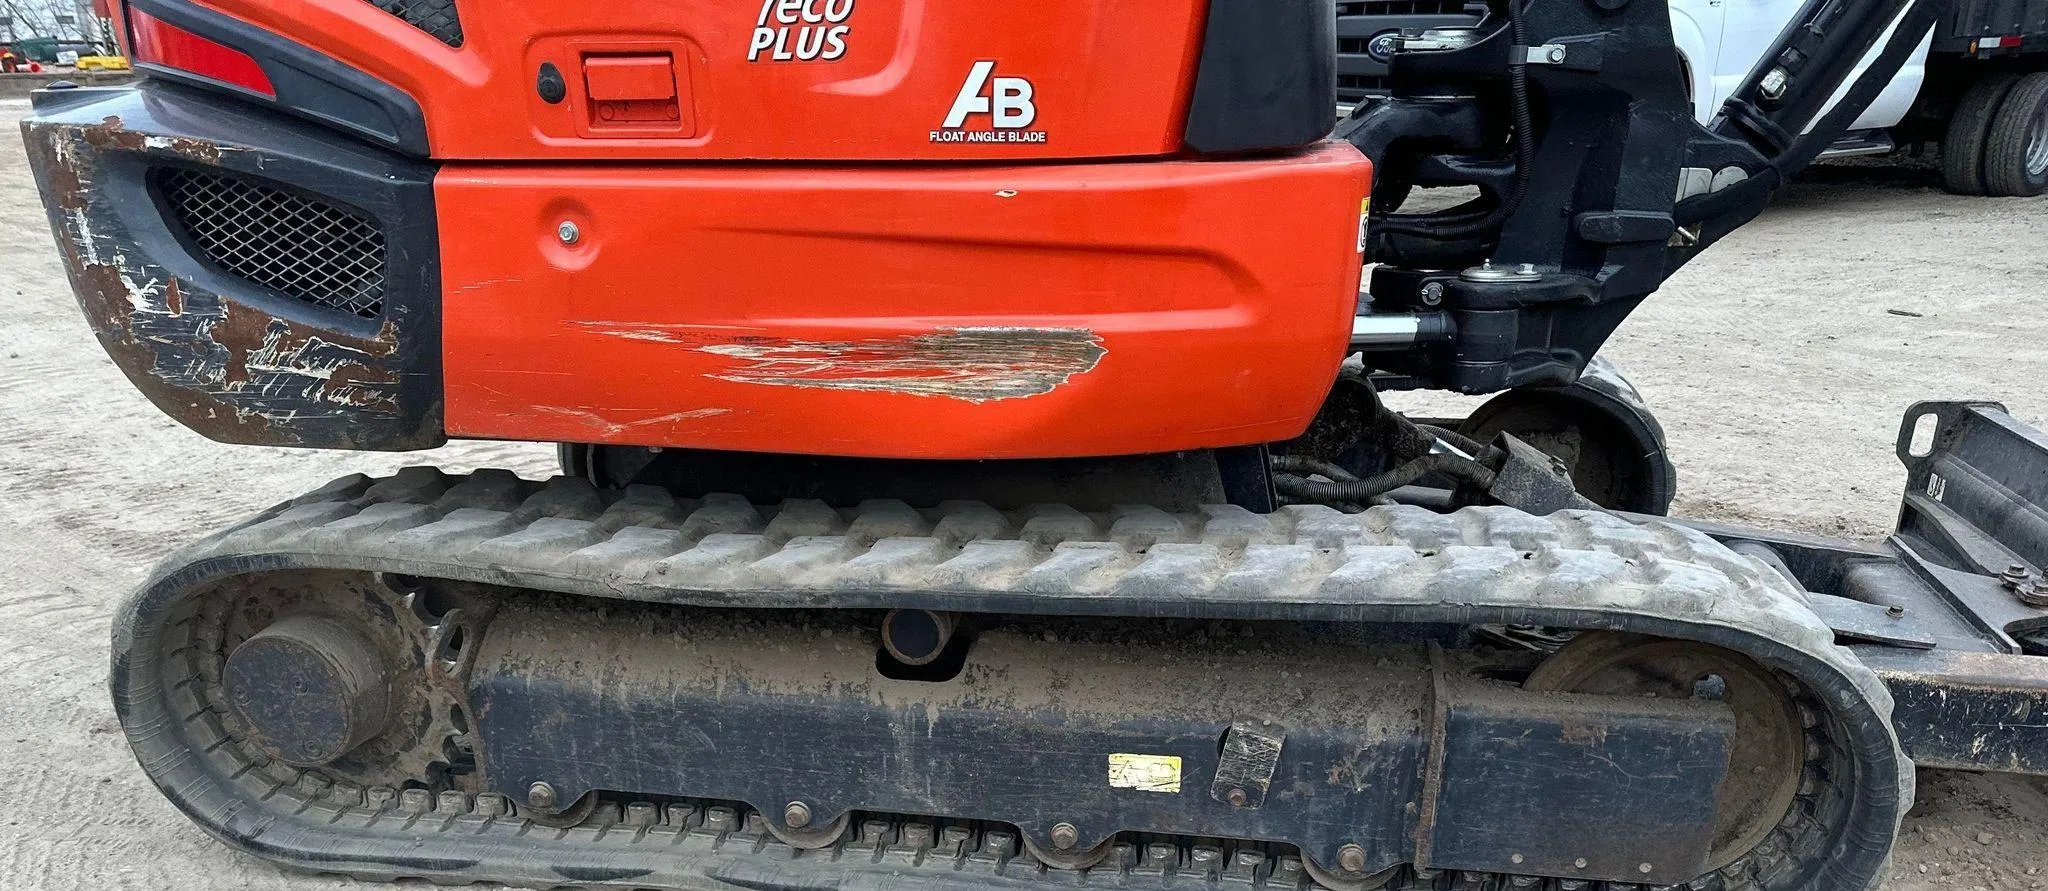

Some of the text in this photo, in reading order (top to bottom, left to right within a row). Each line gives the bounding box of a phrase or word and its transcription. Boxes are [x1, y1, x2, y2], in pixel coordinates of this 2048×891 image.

[747, 25, 850, 61] PLUS
[941, 61, 1036, 128] AB
[929, 131, 1046, 142] FLOAT ANGLE BLADE
